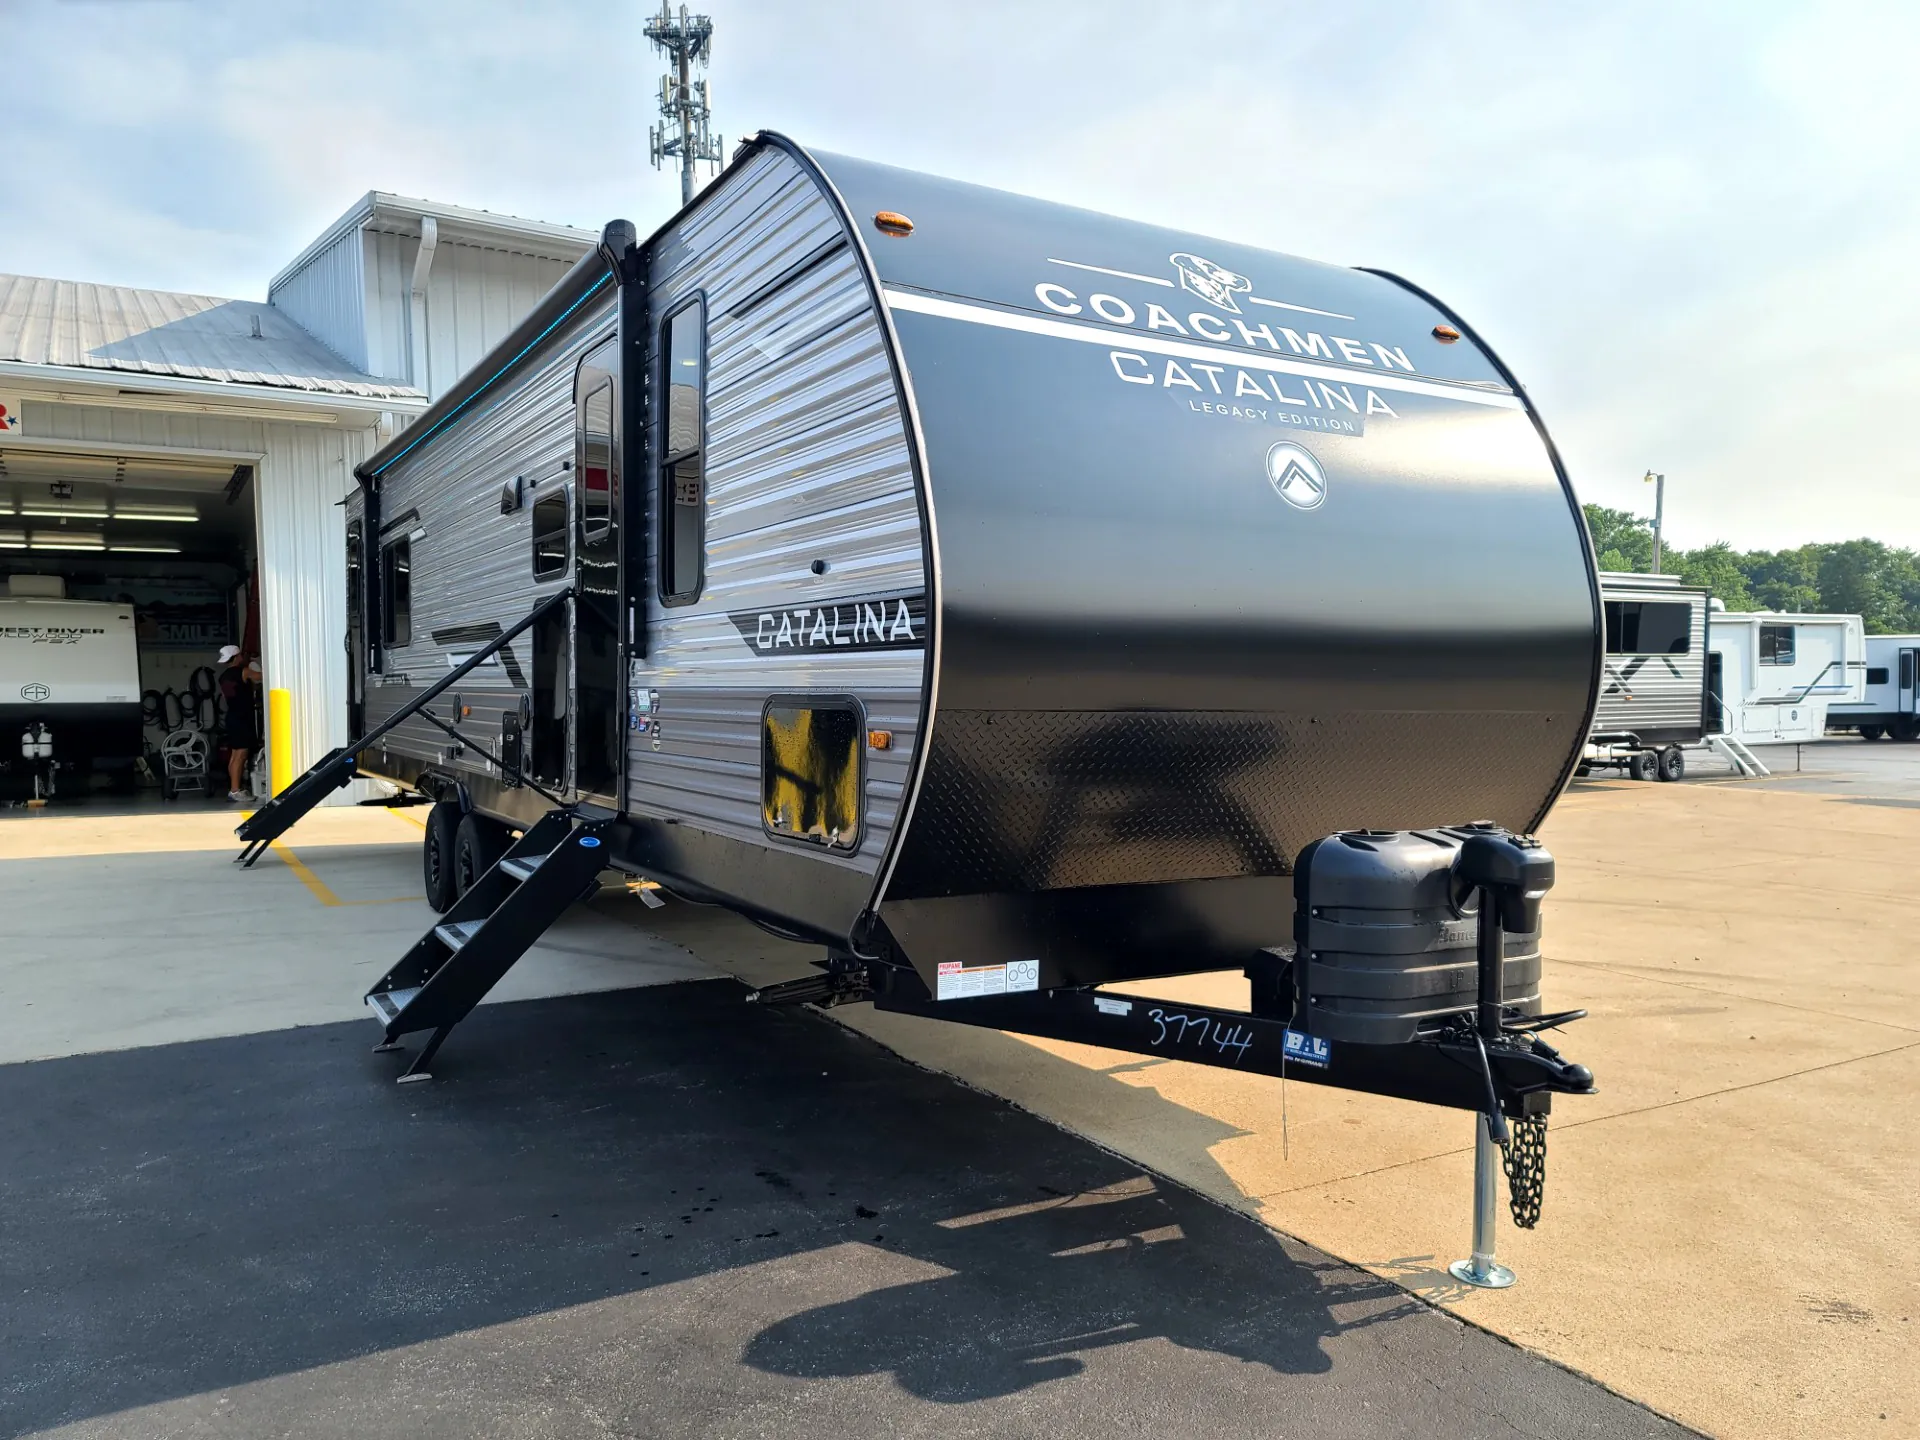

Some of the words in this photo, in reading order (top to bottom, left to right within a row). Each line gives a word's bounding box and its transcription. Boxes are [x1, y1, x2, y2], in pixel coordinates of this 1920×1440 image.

[1034, 282, 1416, 372] COACHMEN
[1109, 350, 1401, 419] CATALINA
[1189, 399, 1268, 421] LEGACY
[1278, 412, 1355, 432] EDITION
[756, 599, 917, 649] CATALINA
[939, 962, 961, 971] PROPANE
[1149, 1008, 1253, 1065] 37744
